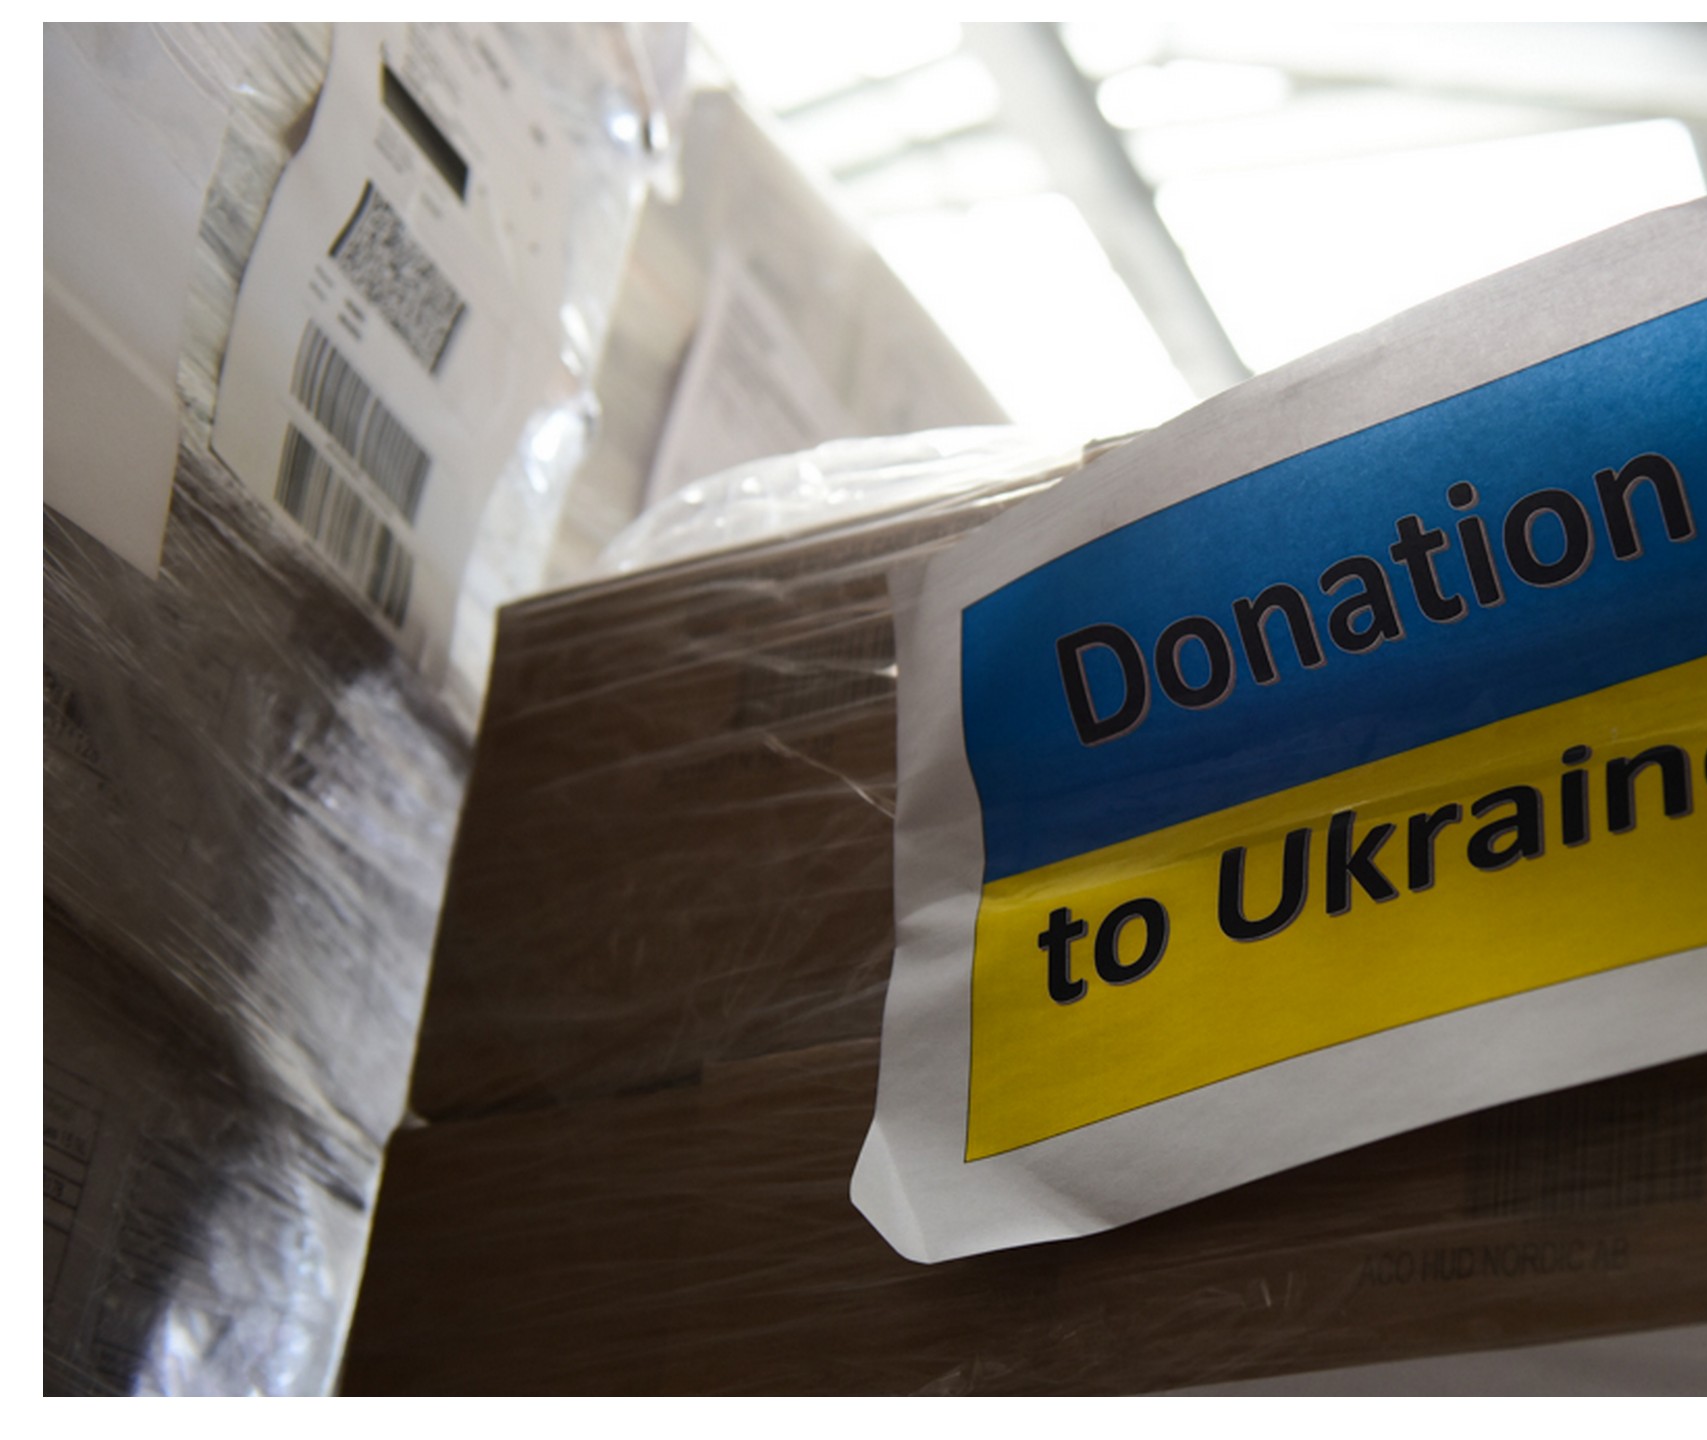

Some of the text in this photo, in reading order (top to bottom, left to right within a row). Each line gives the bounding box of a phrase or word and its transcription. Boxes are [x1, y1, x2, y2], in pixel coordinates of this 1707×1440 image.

[1055, 452, 1698, 746] Donation
[1037, 896, 1169, 1005] to
[1421, 1246, 1475, 1282] HUD
[1483, 1238, 1585, 1278] NORDIC
